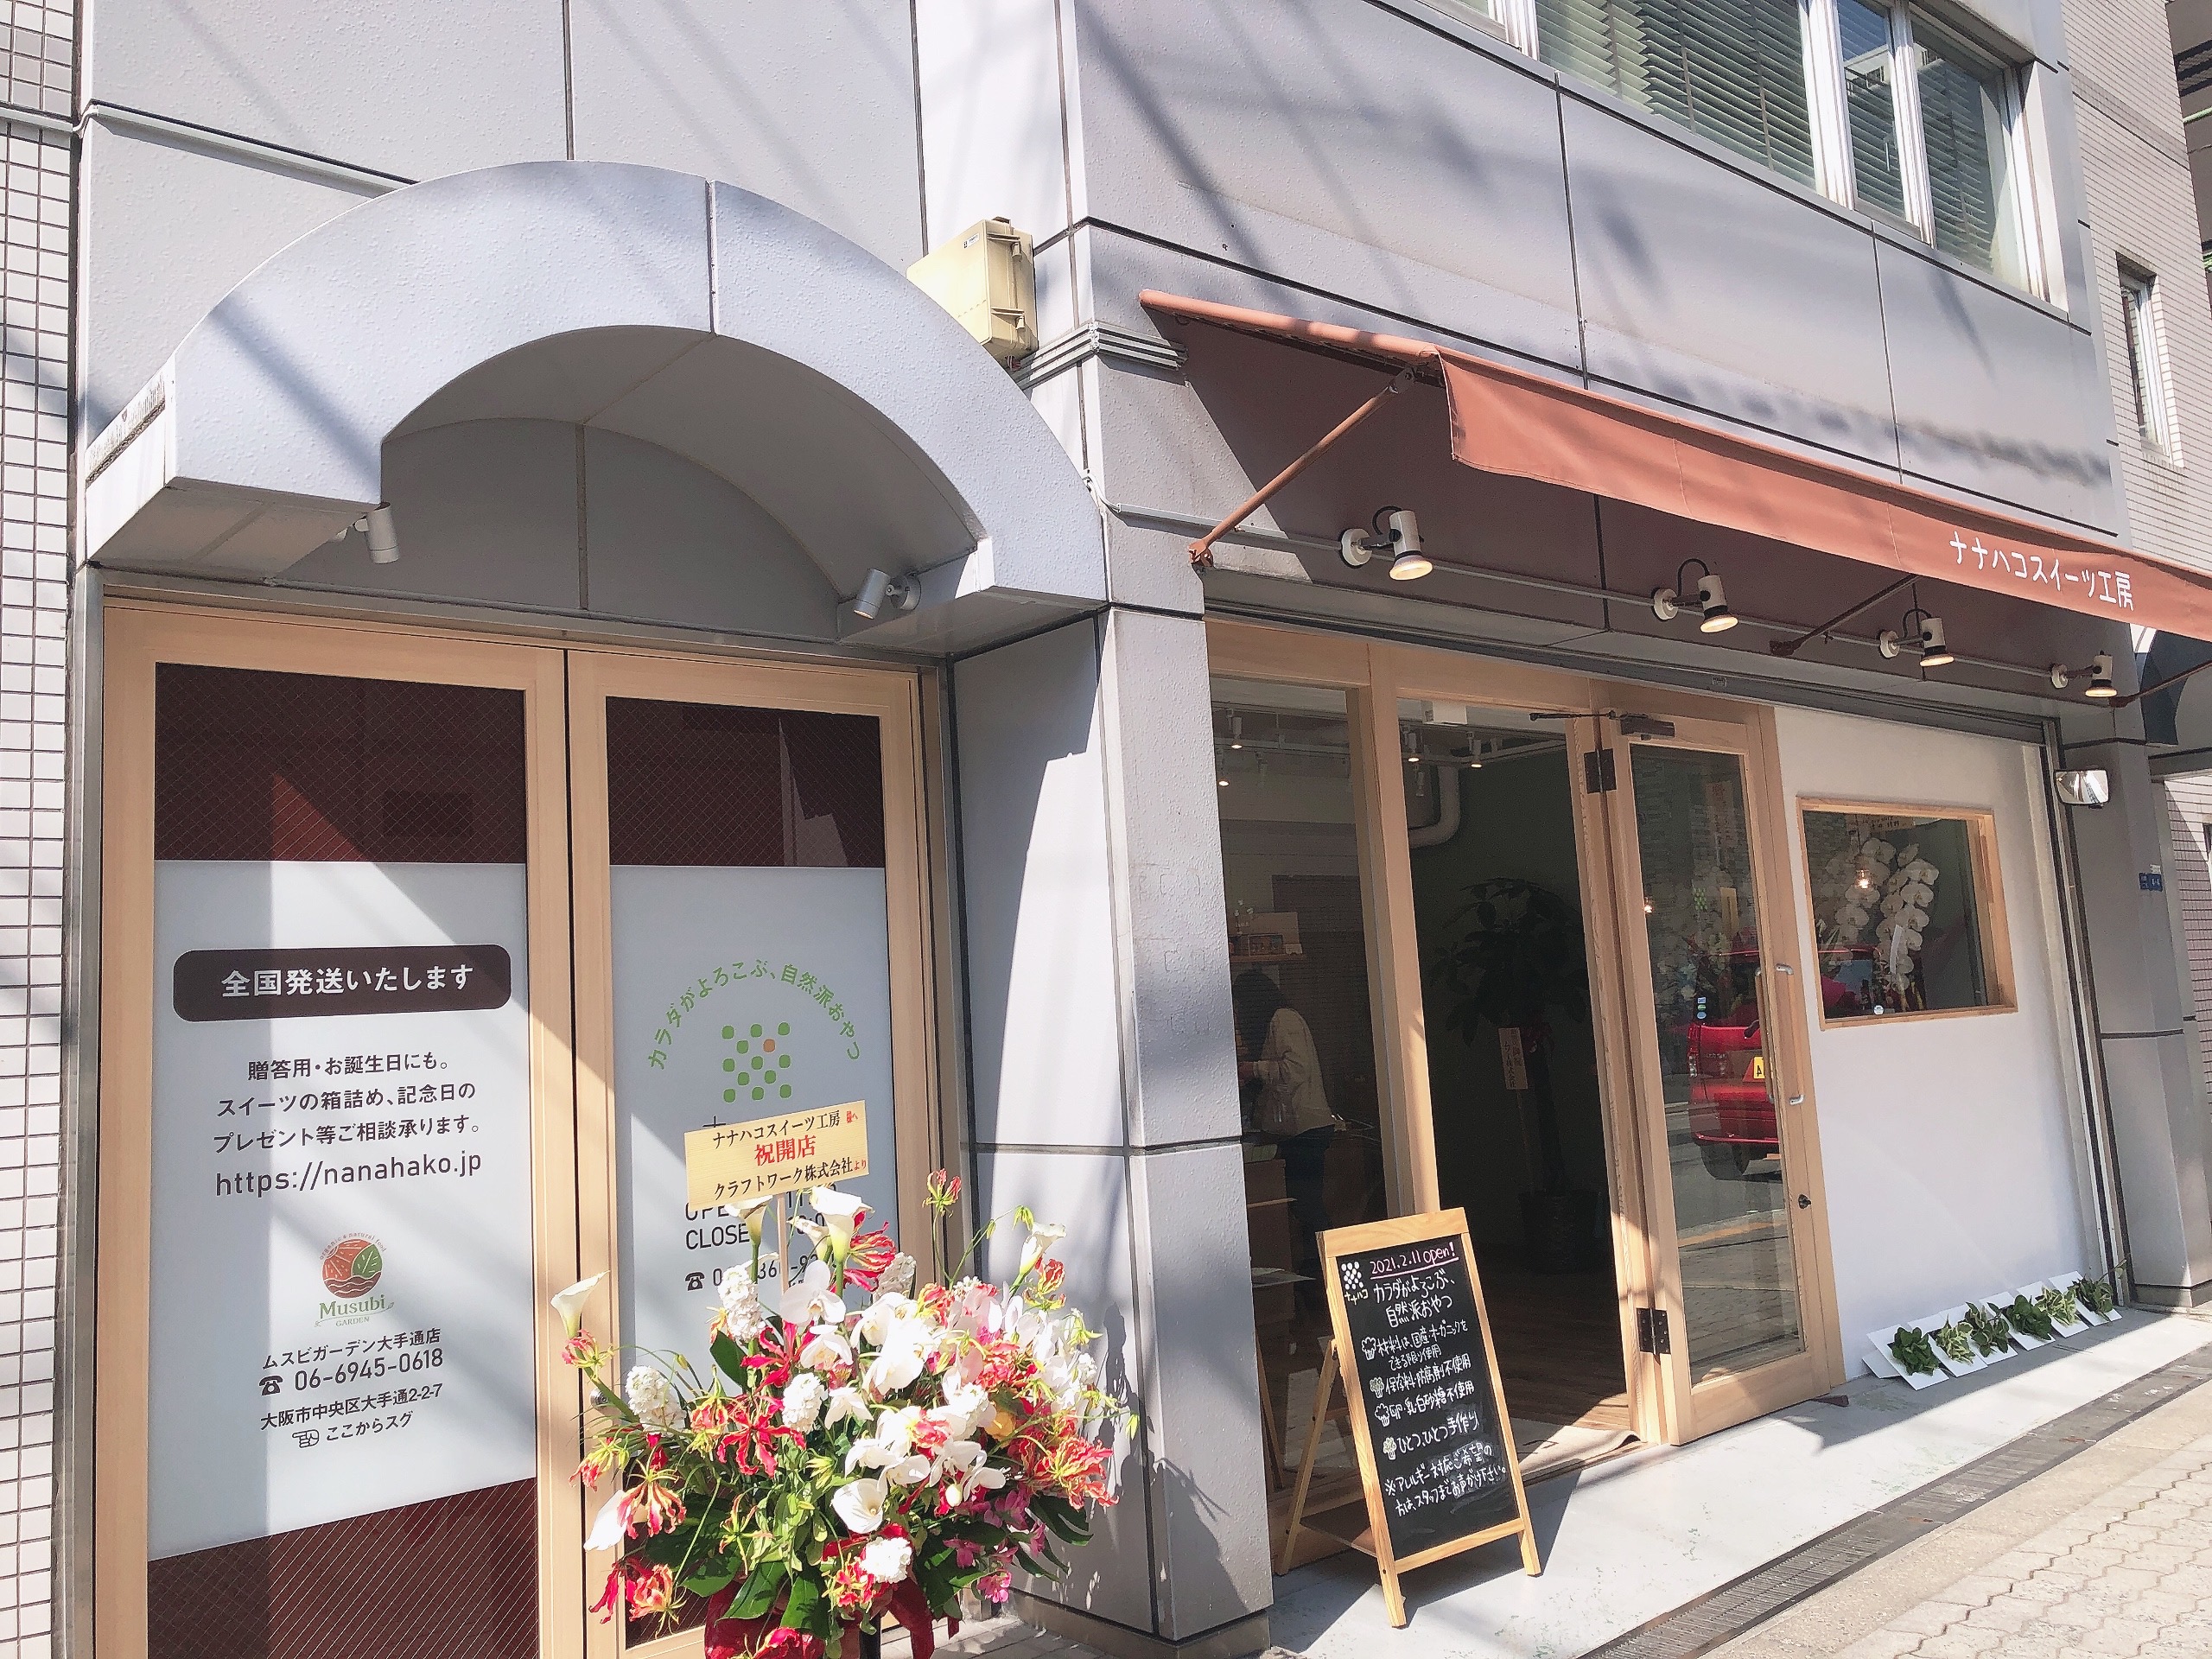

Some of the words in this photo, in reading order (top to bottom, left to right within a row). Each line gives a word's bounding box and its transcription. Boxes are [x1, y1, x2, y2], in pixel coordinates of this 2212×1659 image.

[1949, 531, 2134, 611] ナナハコスイーツ工房
[220, 963, 474, 998] 全国発送いたします
[648, 959, 861, 1071] カラダがよろこぶ、自然派おやつ
[247, 1052, 448, 1082] 贈答用・お誕生日にも。
[217, 1082, 476, 1117] スイーツの箱詰め、記念日の
[213, 1114, 479, 1154] プレゼント等ご相談承ります。
[713, 1110, 841, 1149] ナナハコスイーツ工房
[754, 1135, 817, 1166] 祝開店
[216, 1151, 481, 1198] https://nanahako.jp
[685, 1223, 750, 1250] CLOSE
[319, 1294, 385, 1319] Musubi
[336, 1316, 370, 1327] GARDEN
[1385, 1294, 1452, 1328] 自然派おやつ
[262, 1327, 441, 1370] ムスビガーデン大手通店
[1389, 1344, 1441, 1371] できる限り使用
[295, 1348, 443, 1391] 06-6945-0618
[1386, 1353, 1471, 1395] 保存料・防腐剤不使用
[260, 1383, 443, 1431] 大阪市中央区大手通2-2-7
[1389, 1380, 1475, 1420] 卵・乳・白砂糖不使用
[327, 1410, 413, 1442] ここからスグ
